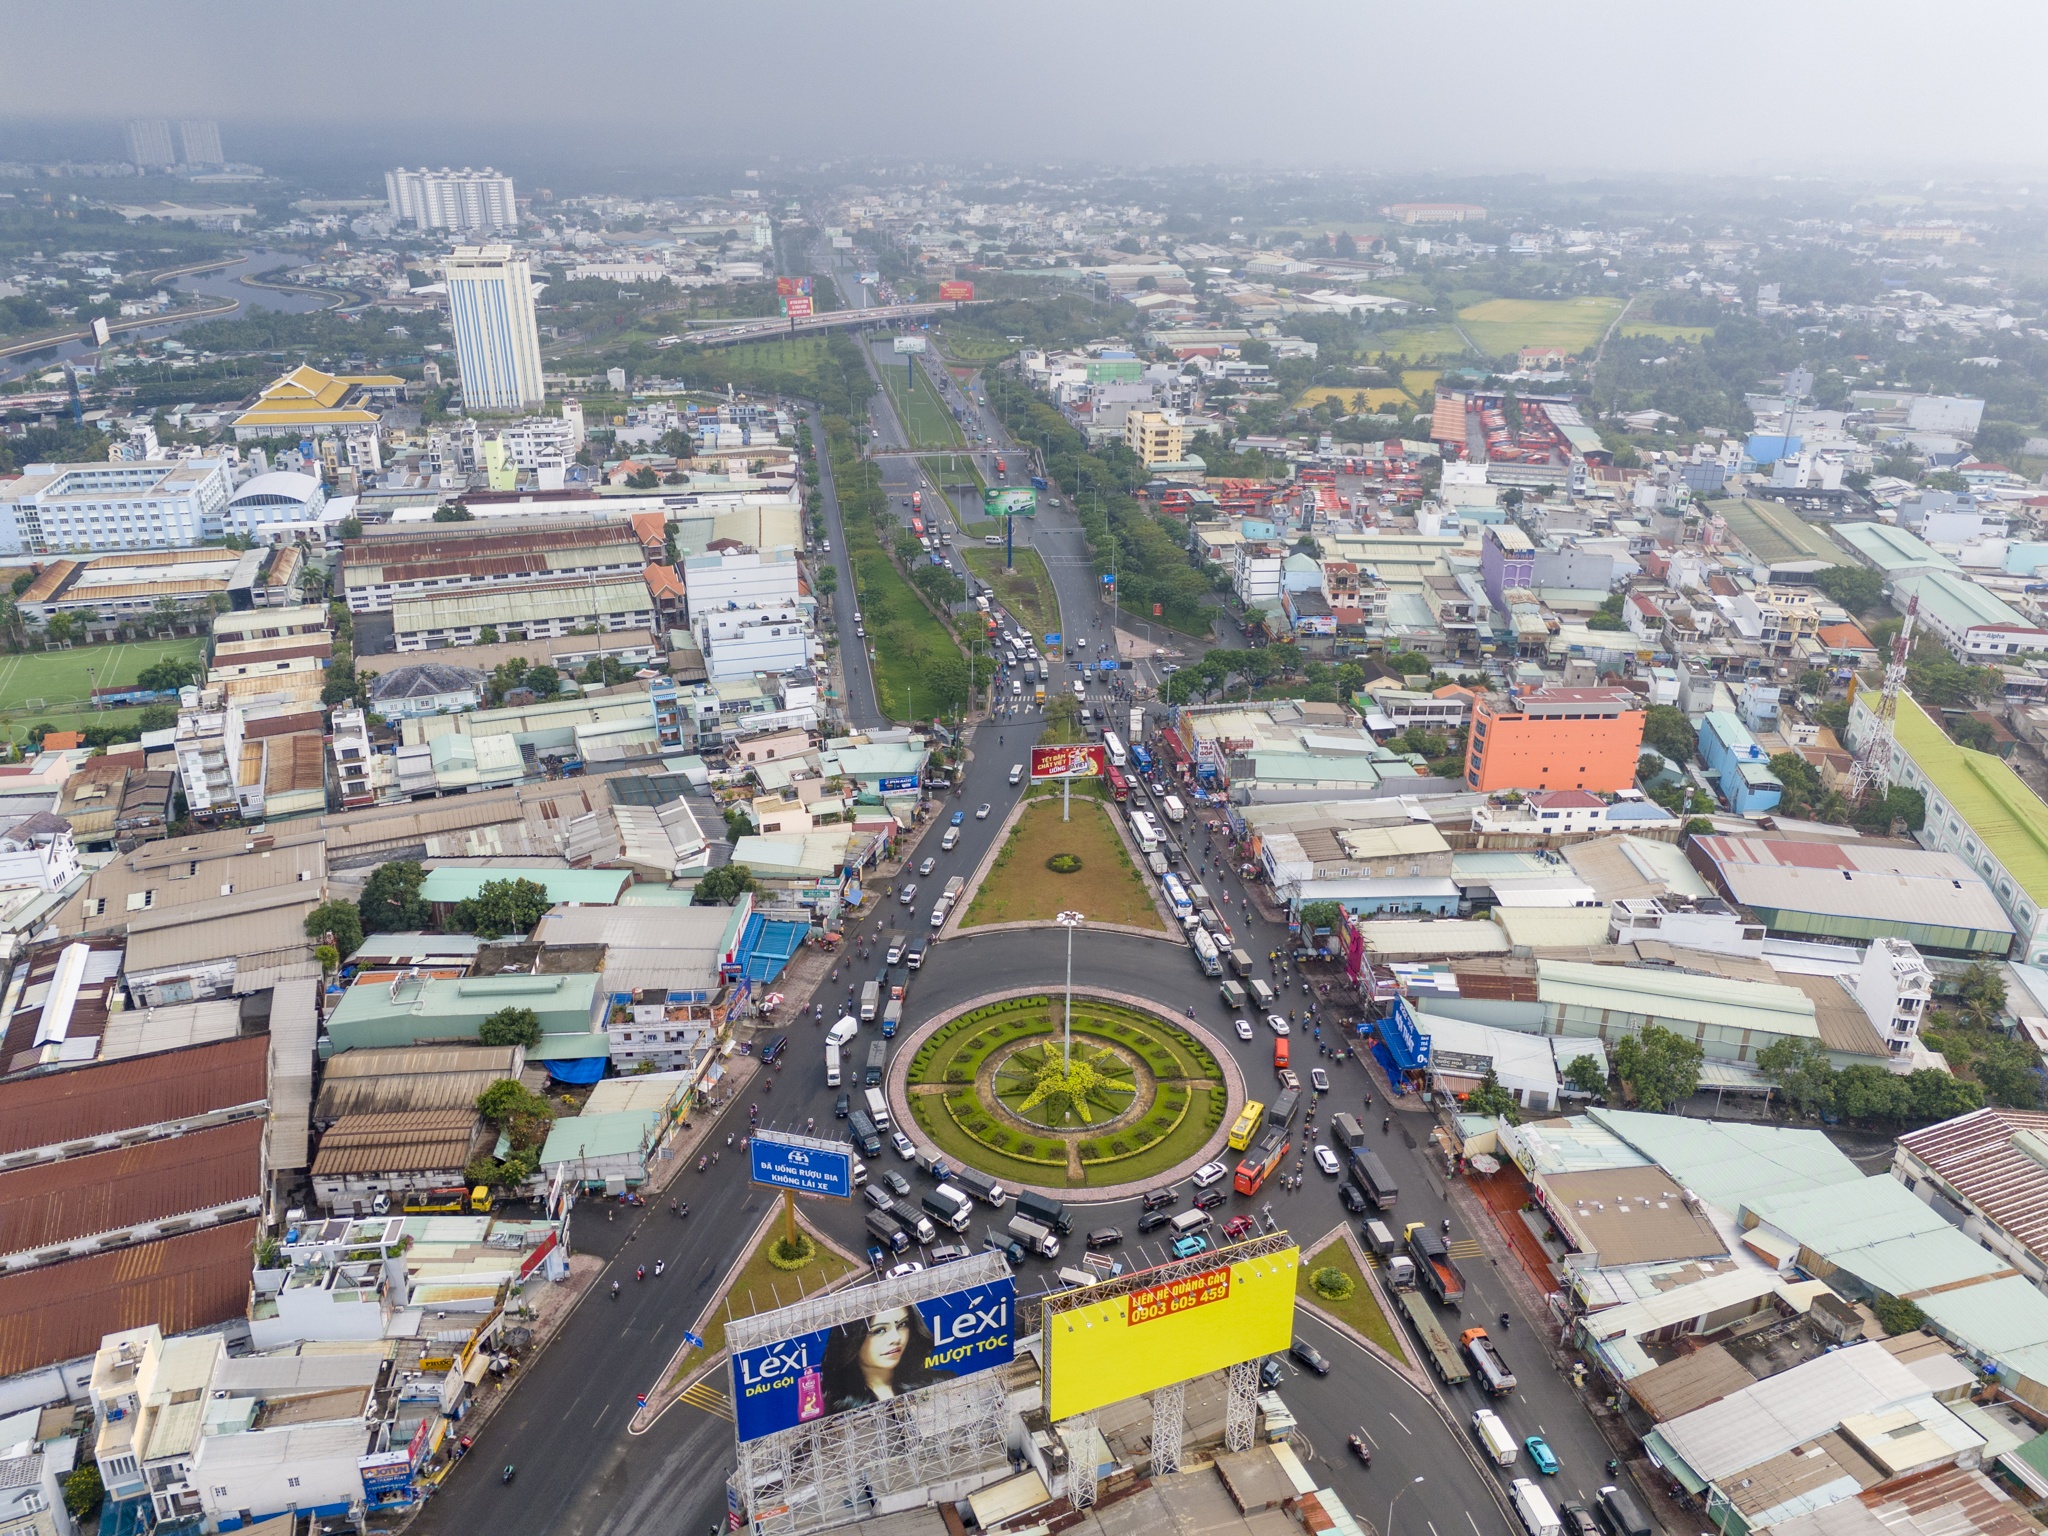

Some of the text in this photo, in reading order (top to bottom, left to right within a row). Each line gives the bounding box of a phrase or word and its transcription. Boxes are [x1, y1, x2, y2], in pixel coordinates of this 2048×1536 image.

[761, 1162, 838, 1182] ĐÃ UỐNG RƯỢU BIA
[772, 1174, 828, 1190] KHÔNG LÁI XE
[1132, 1272, 1226, 1307] LIÊN HỆ QUẢNG CÁO
[1131, 1286, 1226, 1323] 0903 605 459
[924, 1334, 1008, 1369] MƯỢT TÓC
[773, 1376, 794, 1388] GỘI
[376, 1465, 407, 1476] JOTUN
